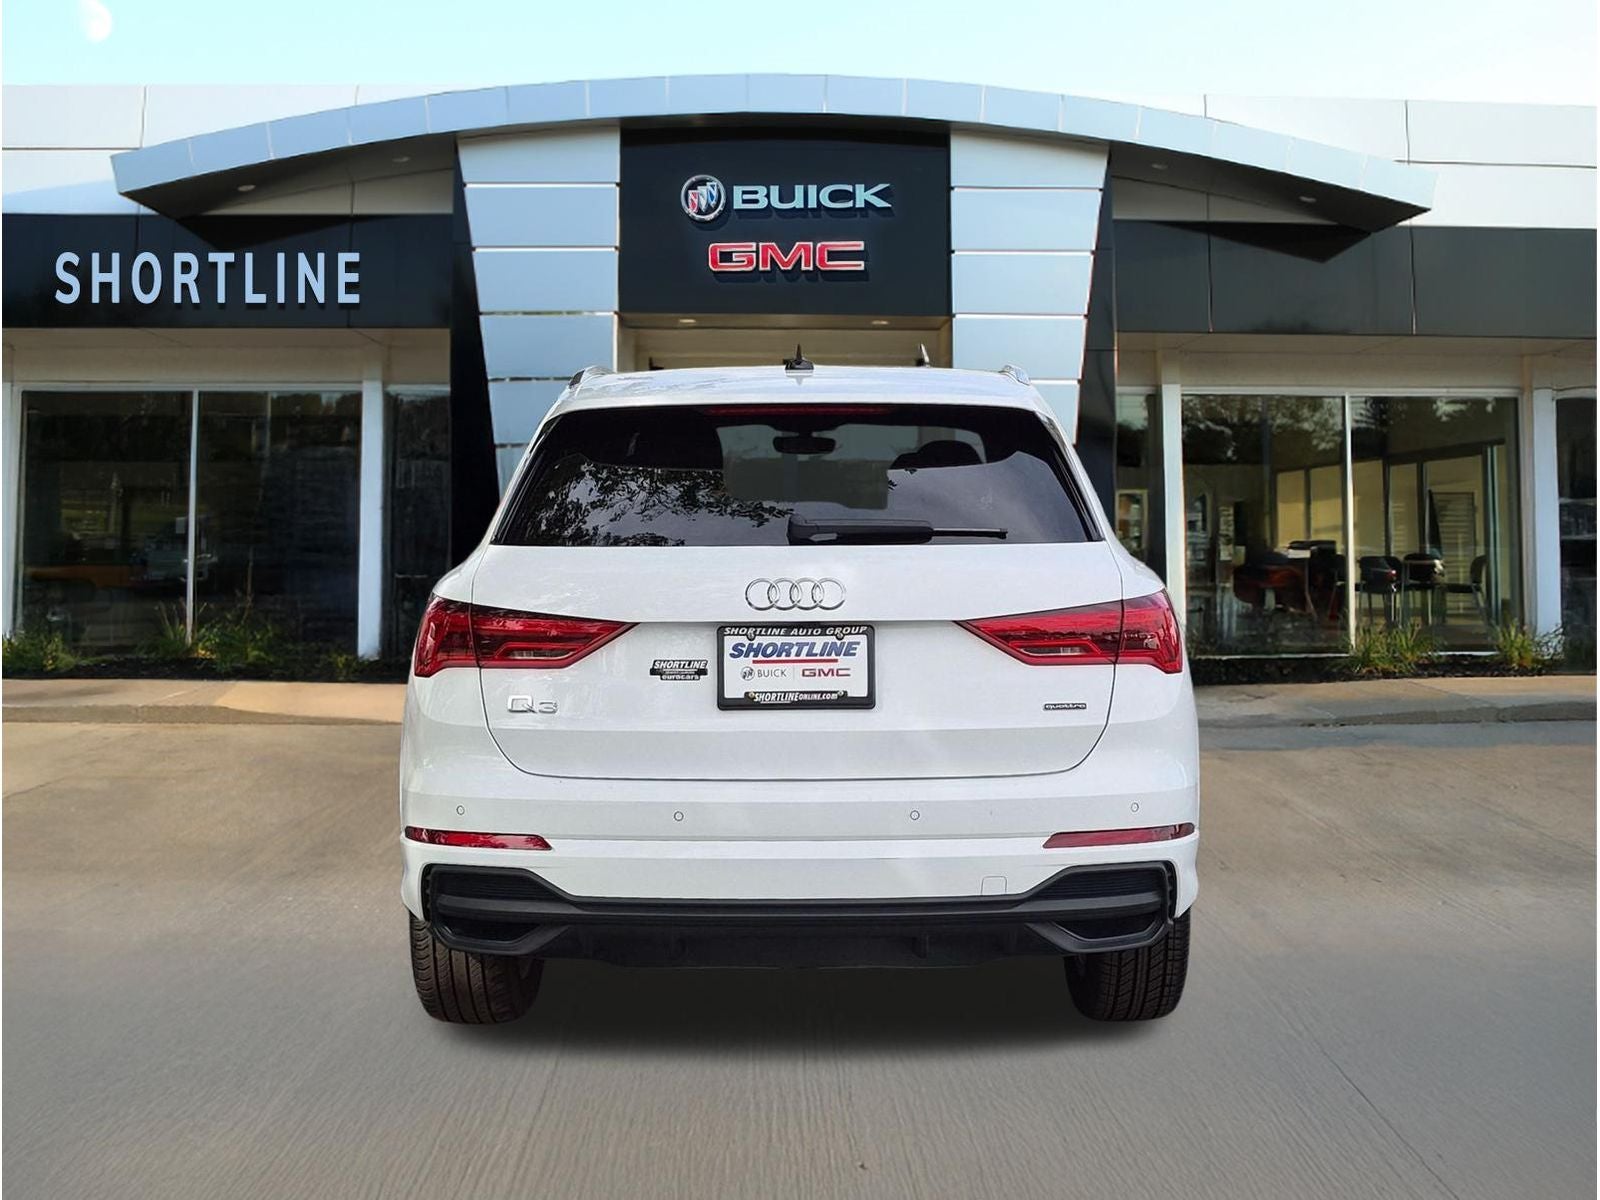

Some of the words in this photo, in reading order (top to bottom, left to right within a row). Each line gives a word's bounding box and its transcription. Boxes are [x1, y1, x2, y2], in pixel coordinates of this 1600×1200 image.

[733, 183, 892, 210] BUICK
[708, 241, 865, 272] GMC
[55, 251, 361, 305] SHORTLINE
[723, 626, 788, 636] SHORTLINE
[790, 627, 822, 636] AUTO
[826, 626, 868, 636] GROUP
[729, 641, 861, 659] SHORTLINE
[653, 660, 707, 669] SHORTLINE
[757, 668, 787, 678] BUICK
[801, 668, 851, 678] GMC
[507, 695, 558, 714] Q3
